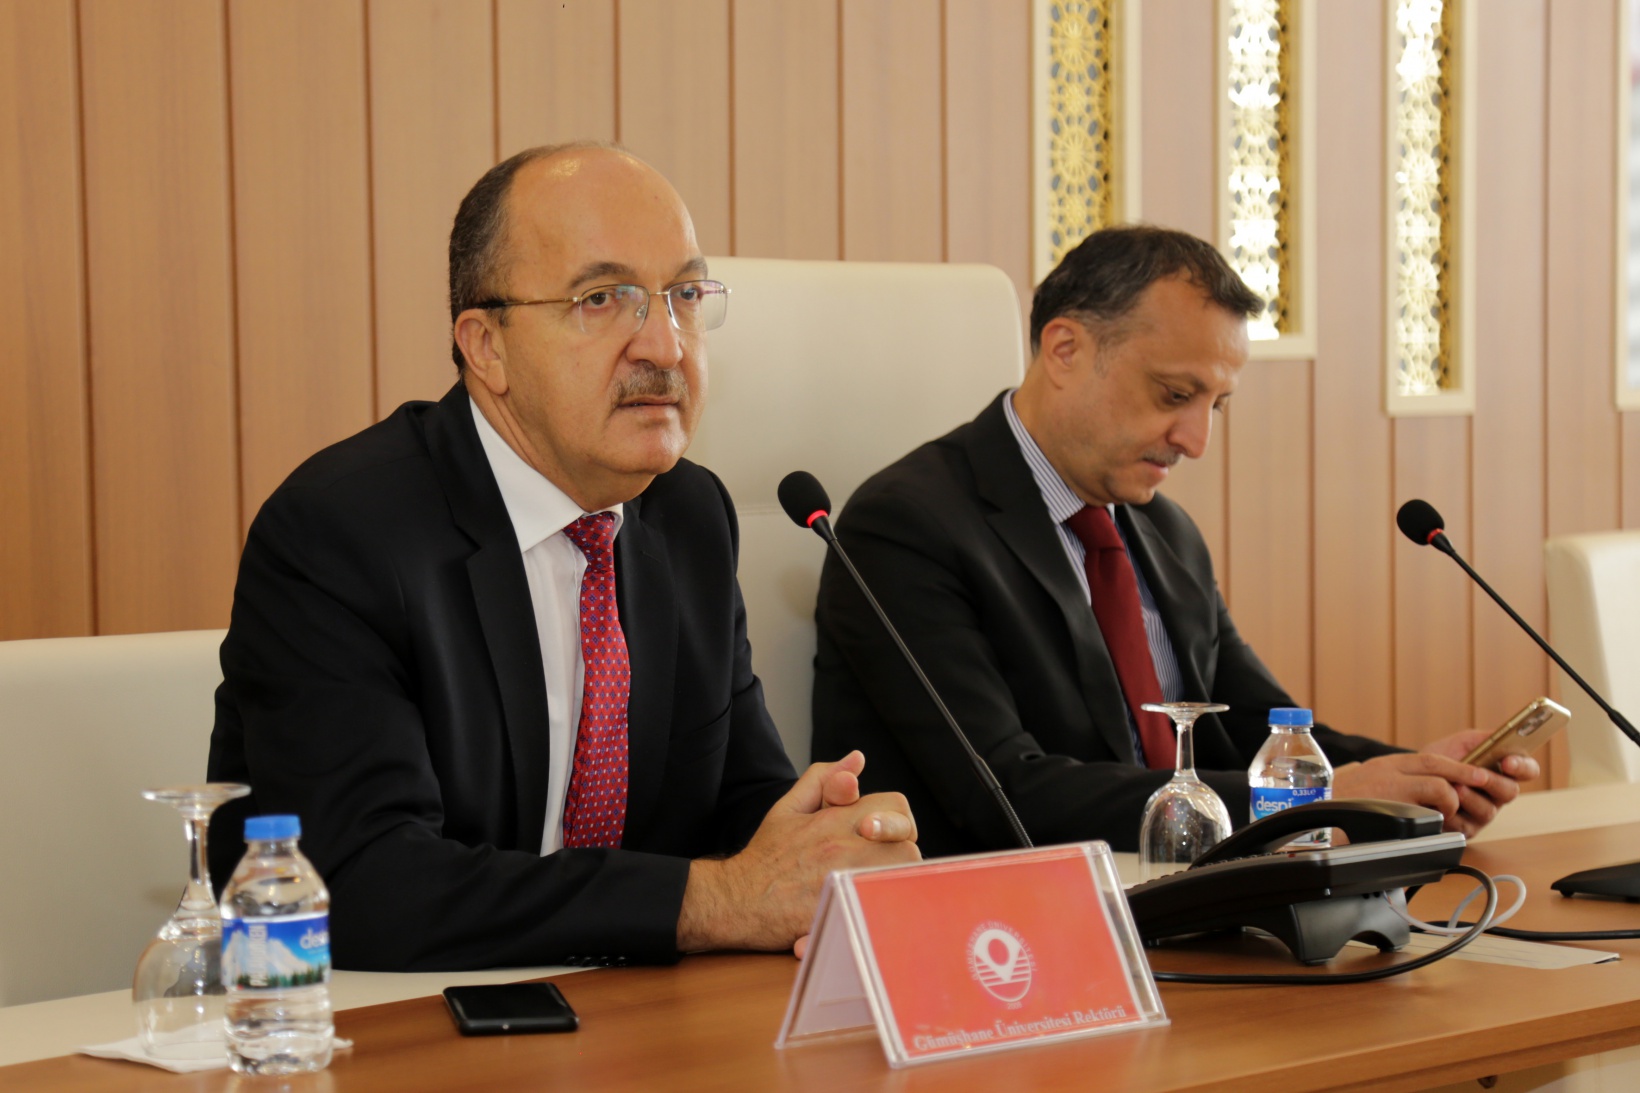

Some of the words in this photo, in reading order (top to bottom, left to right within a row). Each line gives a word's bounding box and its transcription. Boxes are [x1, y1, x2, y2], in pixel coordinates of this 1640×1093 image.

[913, 1027, 994, 1050] Gümüşhane
[995, 1013, 1071, 1037] Üniversitesi
[1074, 1006, 1127, 1025] Rektörü
